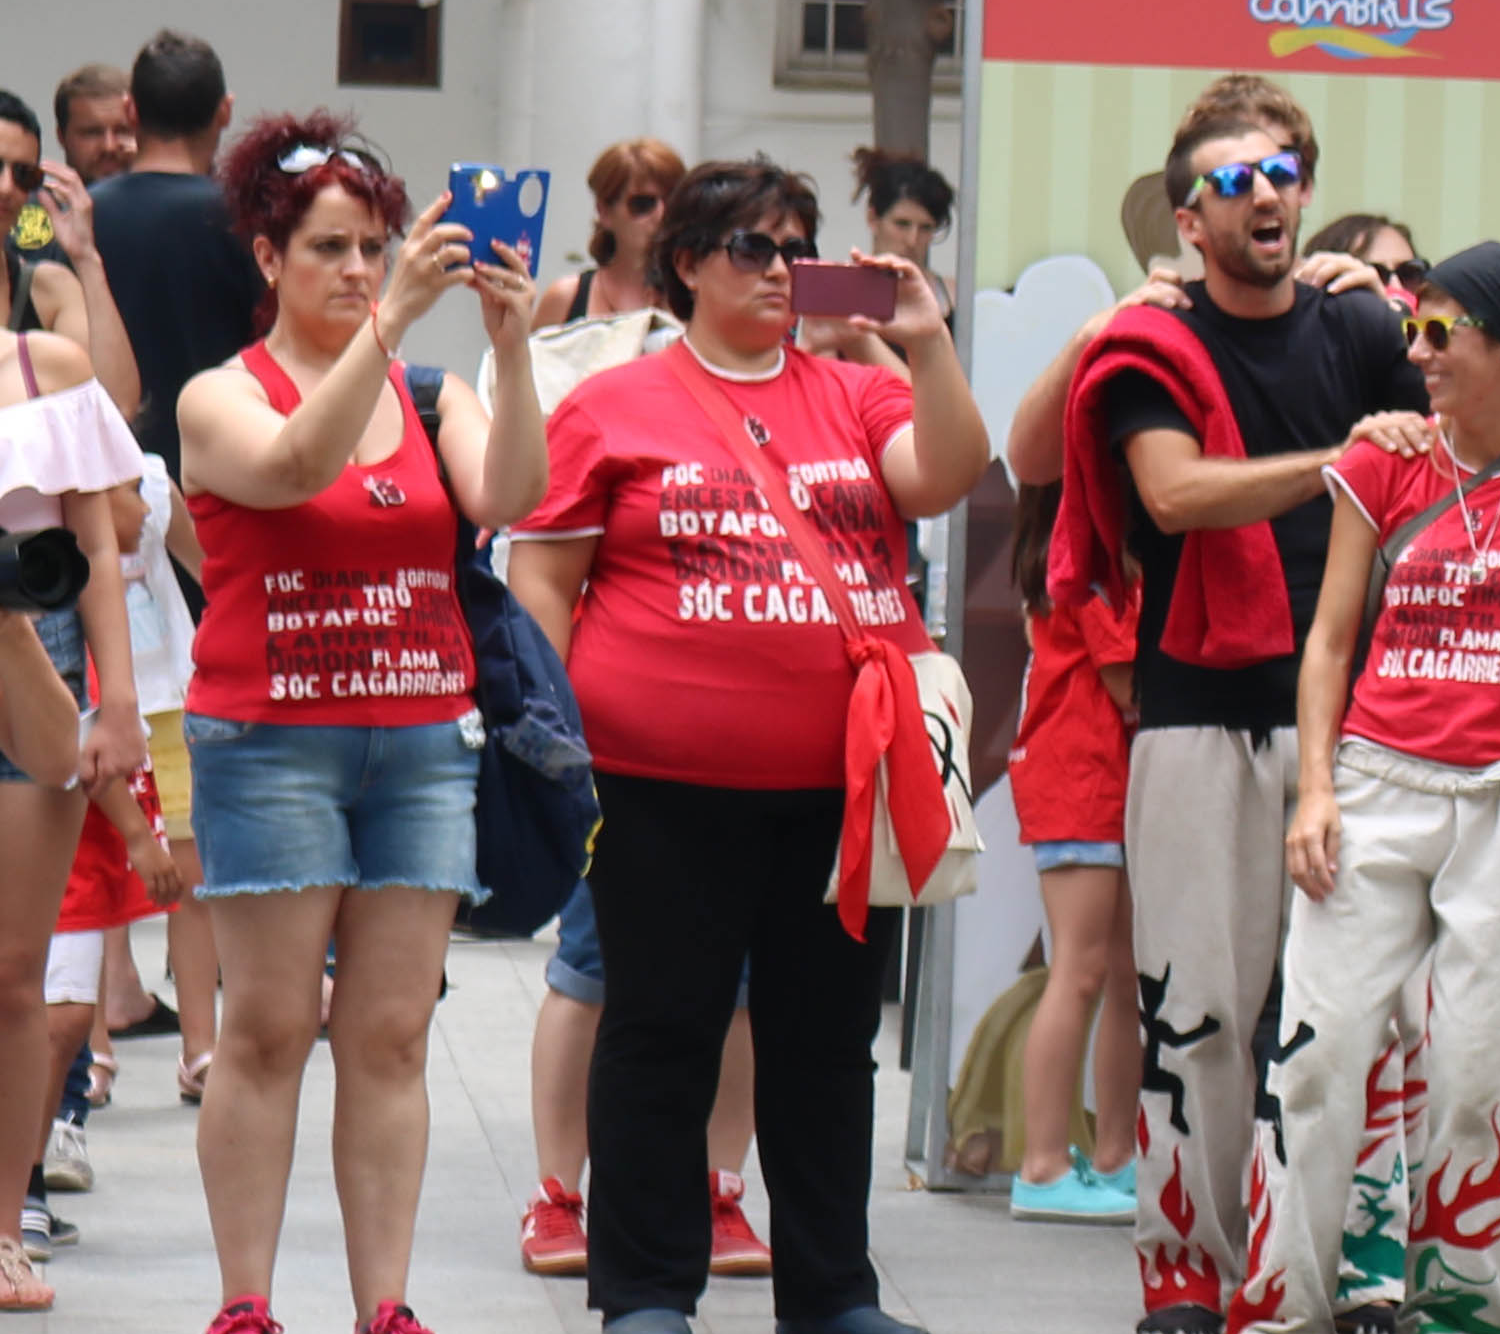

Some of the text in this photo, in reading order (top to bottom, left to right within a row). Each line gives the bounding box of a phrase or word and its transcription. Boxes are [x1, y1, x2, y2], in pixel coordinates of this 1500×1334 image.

[661, 462, 705, 488] FOC
[659, 509, 788, 538] BOTAFO
[264, 569, 305, 595] FOC
[781, 560, 869, 588] FLMA
[267, 608, 398, 633] BOTAFOC
[371, 648, 440, 670] FLAMA
